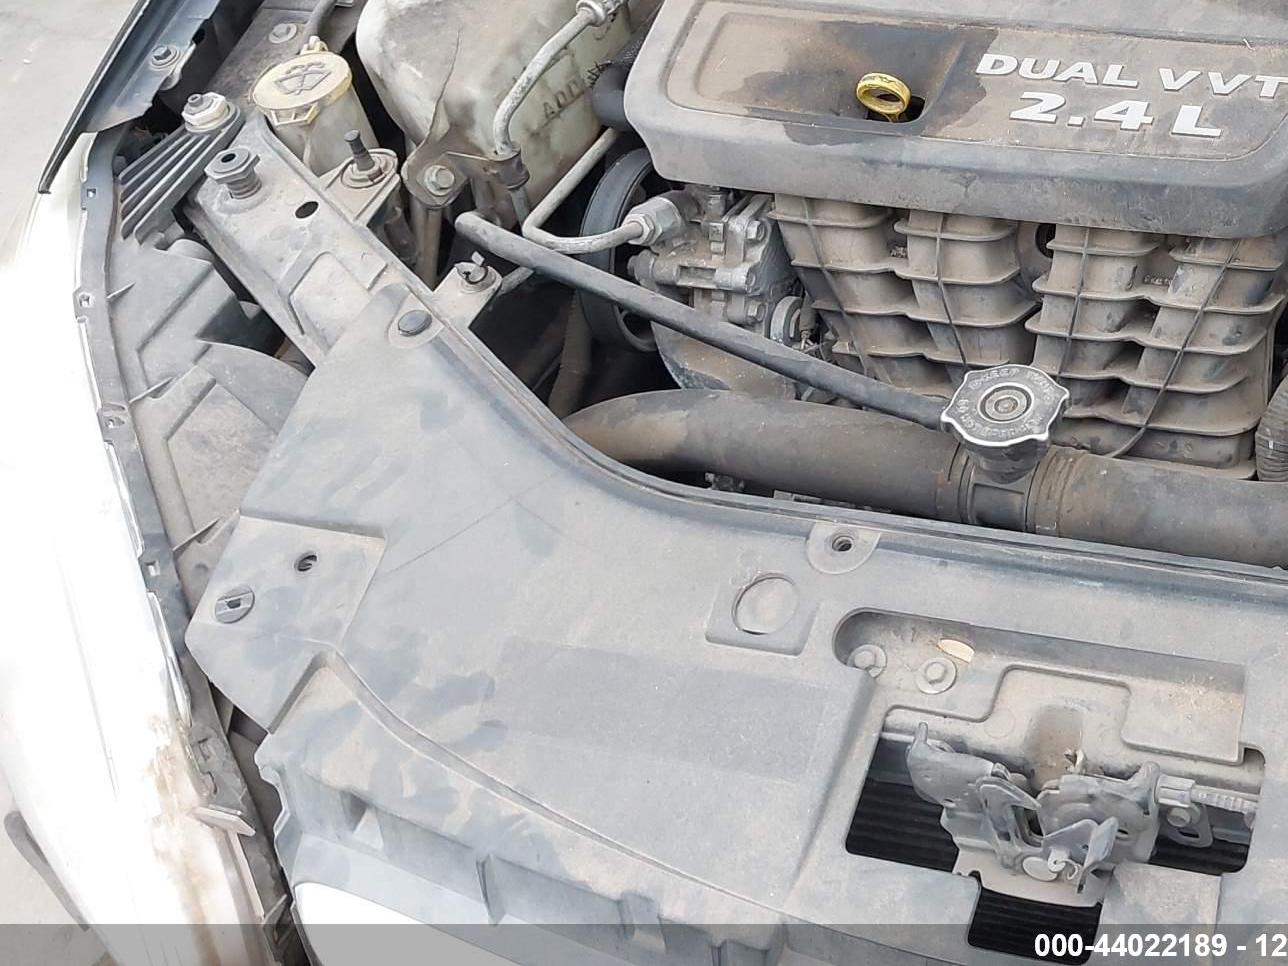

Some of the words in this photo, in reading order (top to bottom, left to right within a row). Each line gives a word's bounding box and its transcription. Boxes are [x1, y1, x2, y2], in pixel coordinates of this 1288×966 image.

[975, 52, 1139, 88] DUAL
[1008, 90, 1155, 131] 2.4
[1170, 104, 1222, 138] L
